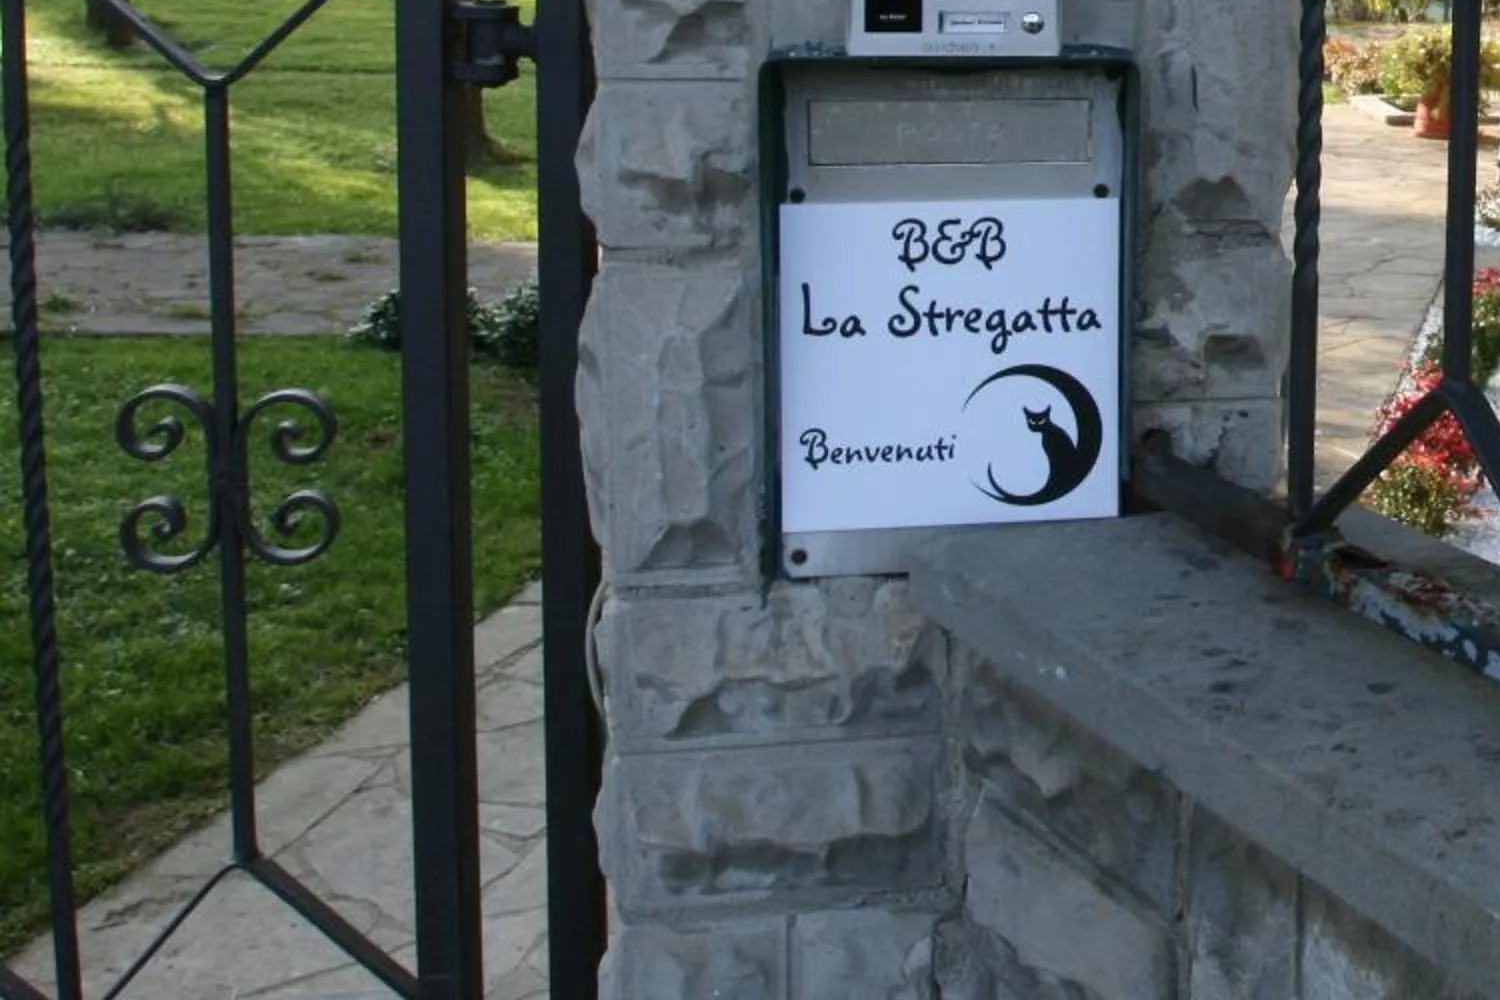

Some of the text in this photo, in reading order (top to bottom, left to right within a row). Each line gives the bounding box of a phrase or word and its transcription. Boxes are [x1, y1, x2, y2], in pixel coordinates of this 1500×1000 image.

[892, 217, 1007, 273] B&B
[801, 282, 1102, 355] La Stregatta
[799, 427, 957, 471] Benvenuti
